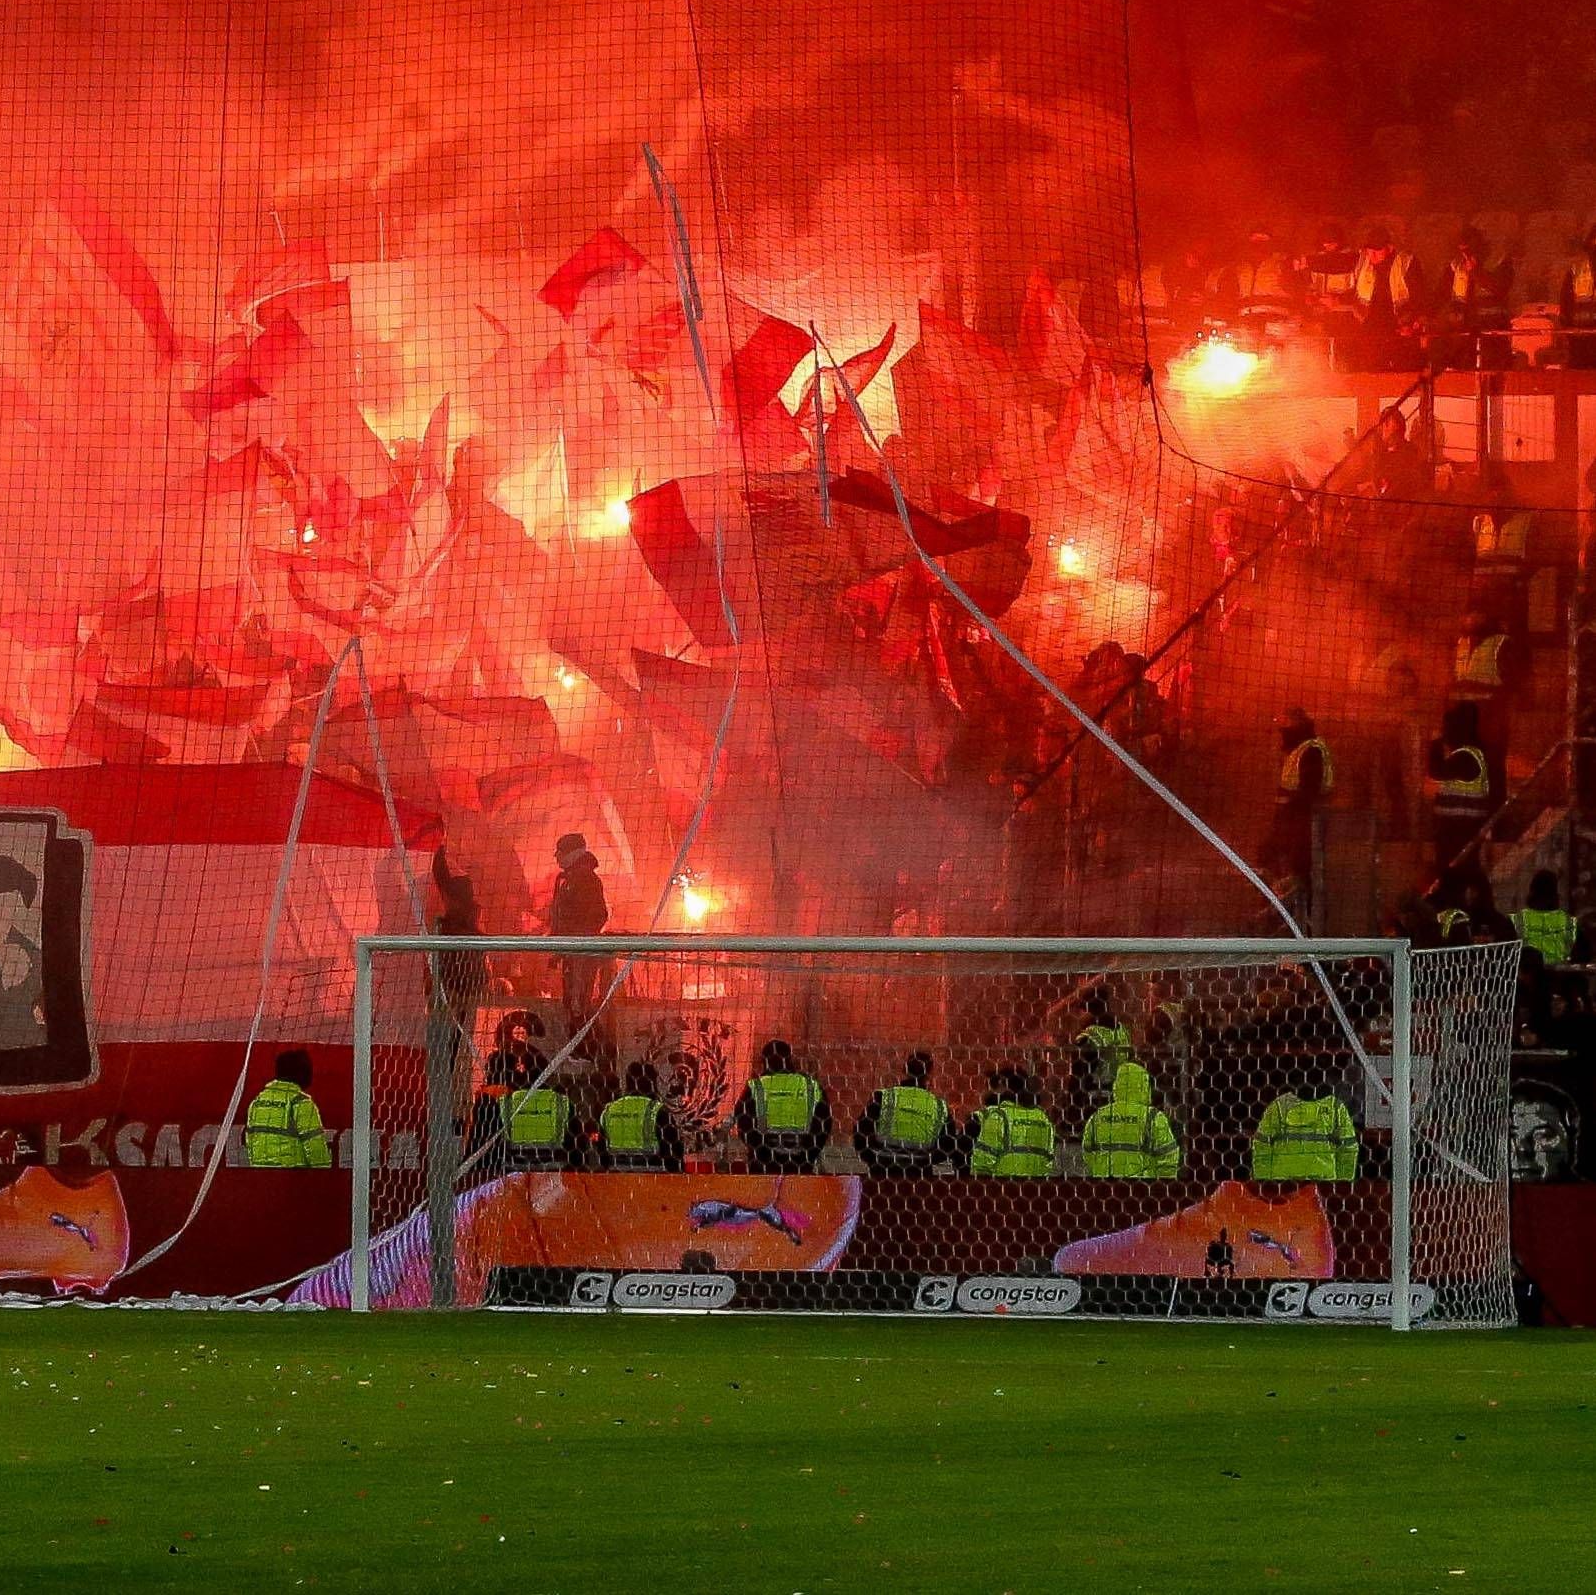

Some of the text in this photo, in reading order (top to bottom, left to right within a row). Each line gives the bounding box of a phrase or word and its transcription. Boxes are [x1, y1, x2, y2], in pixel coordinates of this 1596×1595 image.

[625, 1281, 724, 1301] congstar
[969, 1286, 1069, 1304] congstar
[1322, 1291, 1423, 1310] congstr
